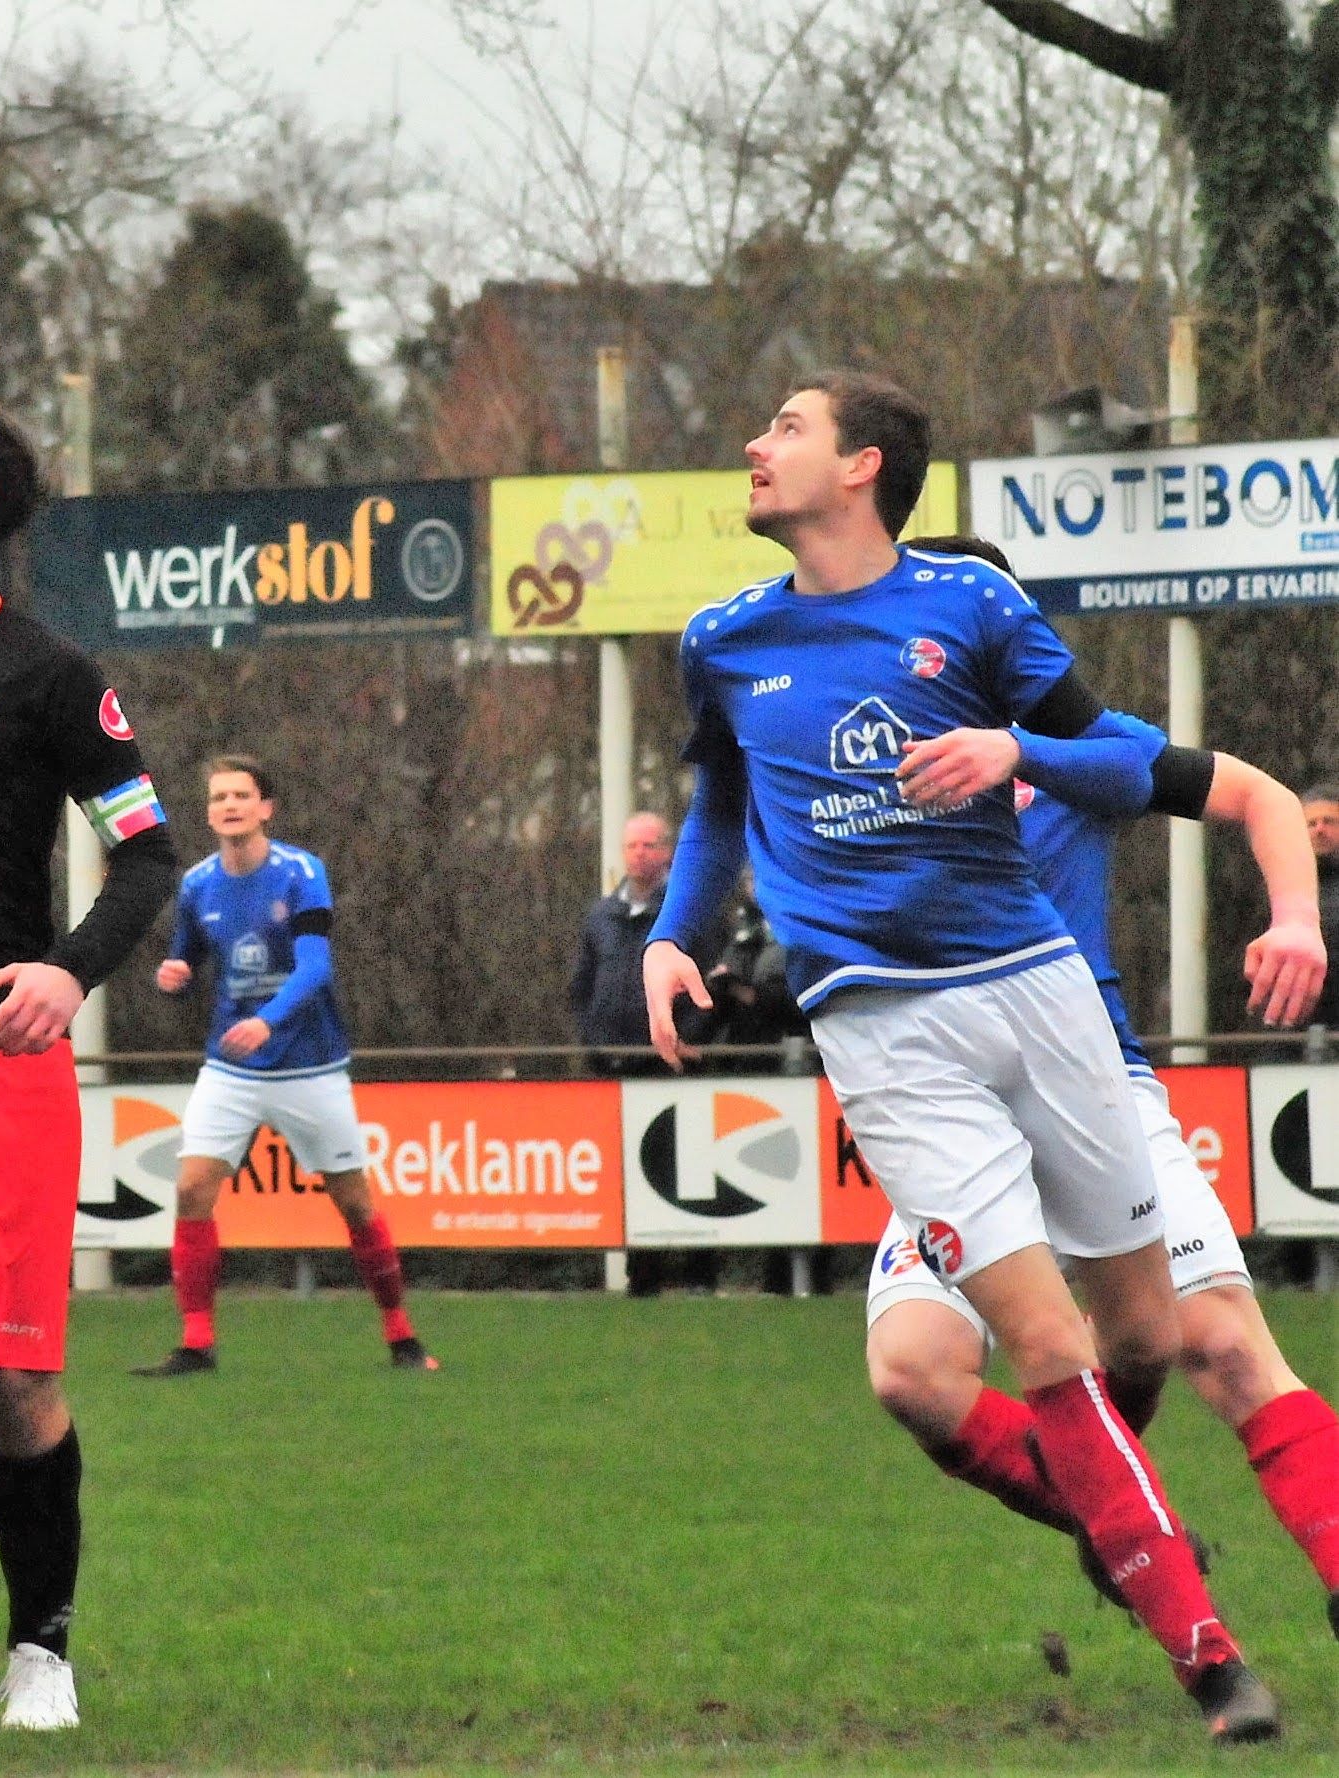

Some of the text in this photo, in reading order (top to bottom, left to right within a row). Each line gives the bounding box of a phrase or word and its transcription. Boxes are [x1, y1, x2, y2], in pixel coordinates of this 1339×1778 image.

[1079, 579, 1189, 609] BOUWEN
[1196, 576, 1225, 604] OP
[752, 674, 792, 697] JAKO
[360, 1120, 602, 1196] Reklame
[1171, 1239, 1204, 1260] AKO
